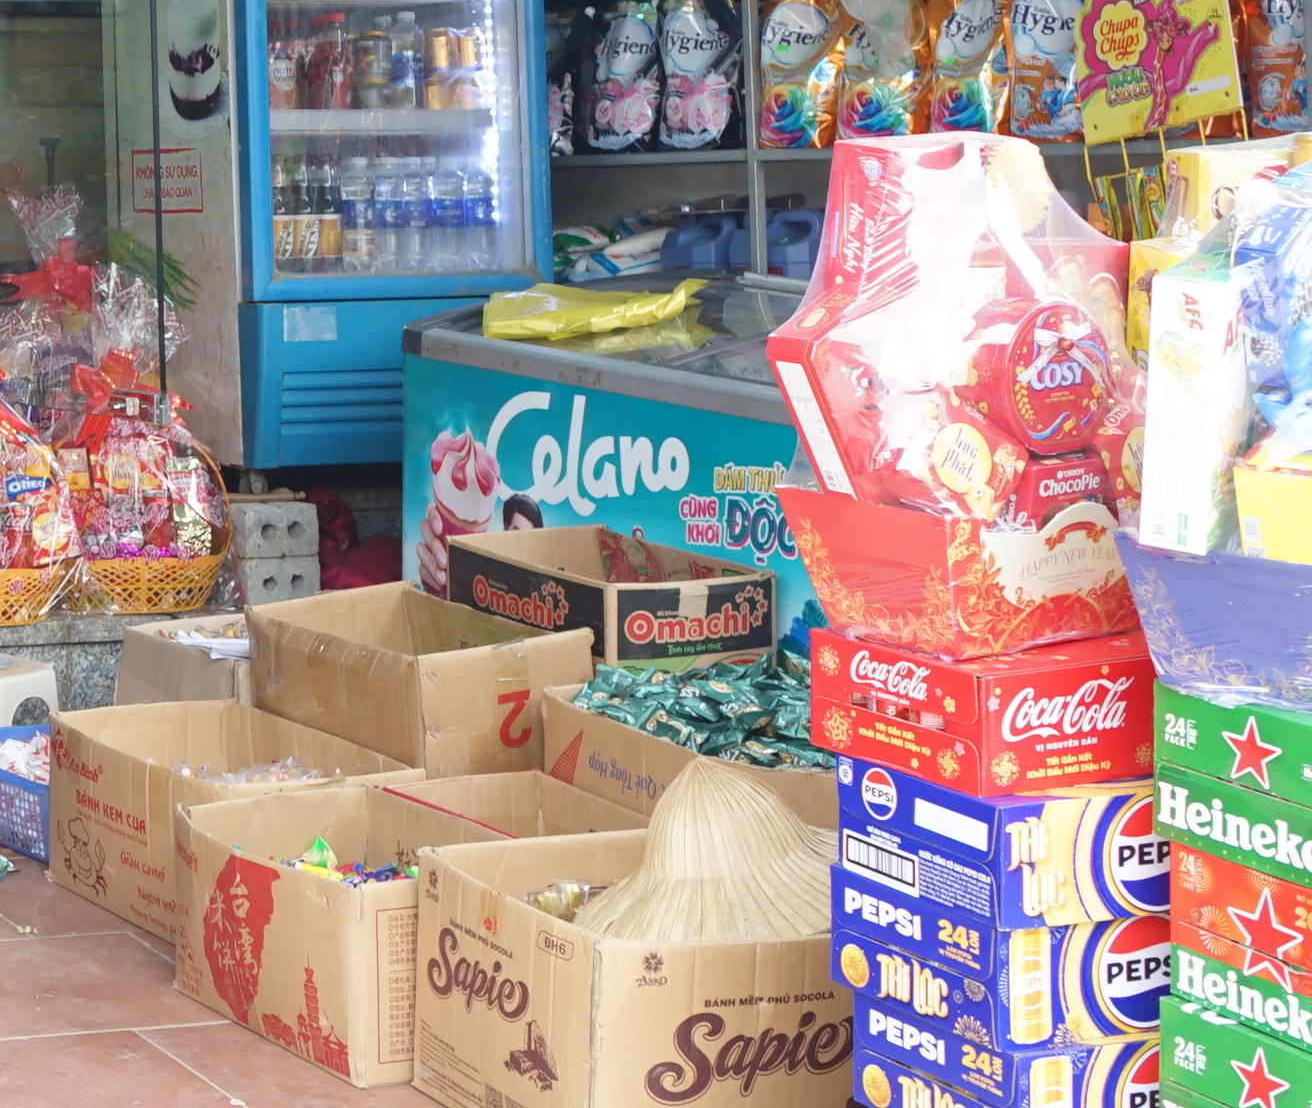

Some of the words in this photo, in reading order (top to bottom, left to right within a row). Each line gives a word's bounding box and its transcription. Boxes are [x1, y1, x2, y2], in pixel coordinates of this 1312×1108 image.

[1099, 16, 1139, 40] Chupa
[1099, 33, 1140, 59] Chups
[1183, 293, 1204, 331] AFC
[1030, 360, 1085, 391] COSY
[485, 392, 690, 517] Celano
[8, 477, 48, 493] OREO
[1039, 474, 1100, 498] ChocoPie
[1063, 469, 1085, 479] ORION
[680, 495, 717, 518] CÙNG
[1020, 556, 1060, 580] HAPPY
[1063, 548, 1086, 568] NEW
[1090, 544, 1118, 561] YEAR
[473, 575, 554, 629] Omachi
[627, 603, 750, 643] Omachi
[850, 650, 930, 700] Coca-Cola
[1001, 676, 1134, 742] Coca-Cola
[1165, 713, 1186, 739] 24
[1165, 734, 1185, 748] PACK
[1046, 739, 1079, 750] NGUYÊN
[1046, 755, 1060, 766] Tết
[1062, 754, 1077, 765] Gắn
[1078, 751, 1092, 763] Kết
[865, 784, 894, 804] PEPSI
[76, 789, 100, 815] BÁNH
[103, 803, 123, 825] KEM
[126, 814, 146, 835] CUA
[1006, 817, 1048, 871] TÀI
[1179, 851, 1195, 873] 24
[1022, 861, 1067, 917] LỘC
[844, 887, 921, 941] PEPSI
[544, 936, 566, 956] ĐH6
[937, 919, 967, 950] 24
[969, 929, 980, 955] LON
[427, 927, 530, 1022] Sapie
[636, 975, 667, 987] ANKO
[876, 953, 911, 1002] TÀI
[913, 959, 948, 1018] LỘC
[705, 996, 736, 1008] BÁNH
[768, 992, 790, 1005] PHỦ
[794, 991, 835, 1004] SOCOLA
[869, 1009, 945, 1066] PEPSI
[1175, 1037, 1195, 1061] 24
[645, 1011, 854, 1107] Sapie
[961, 1045, 992, 1076] 24
[993, 1056, 1003, 1082] LON
[1174, 1056, 1194, 1073] PACK
